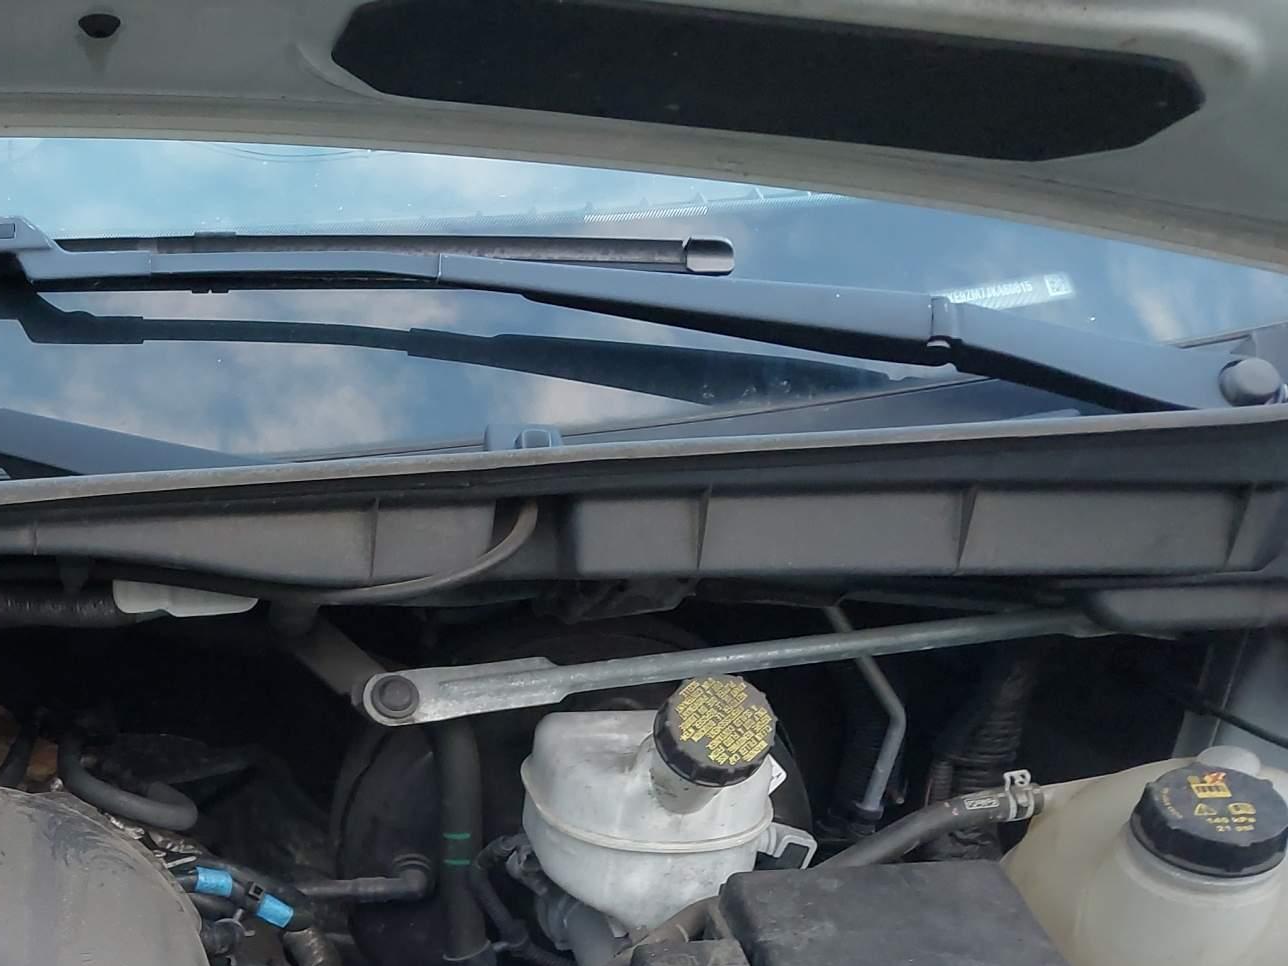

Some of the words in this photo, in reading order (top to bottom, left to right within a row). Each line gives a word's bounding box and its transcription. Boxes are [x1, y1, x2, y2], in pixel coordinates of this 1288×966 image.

[732, 709, 752, 726] SEALED
[752, 707, 767, 720] ONLY
[742, 718, 755, 728] DOT
[751, 714, 772, 731] BEFORE
[722, 732, 739, 746] FLUID
[754, 725, 772, 740] CLEAN
[708, 745, 724, 759] FROM
[738, 738, 757, 755] FILLER
[715, 753, 728, 764] USE
[727, 753, 740, 765] CAP
